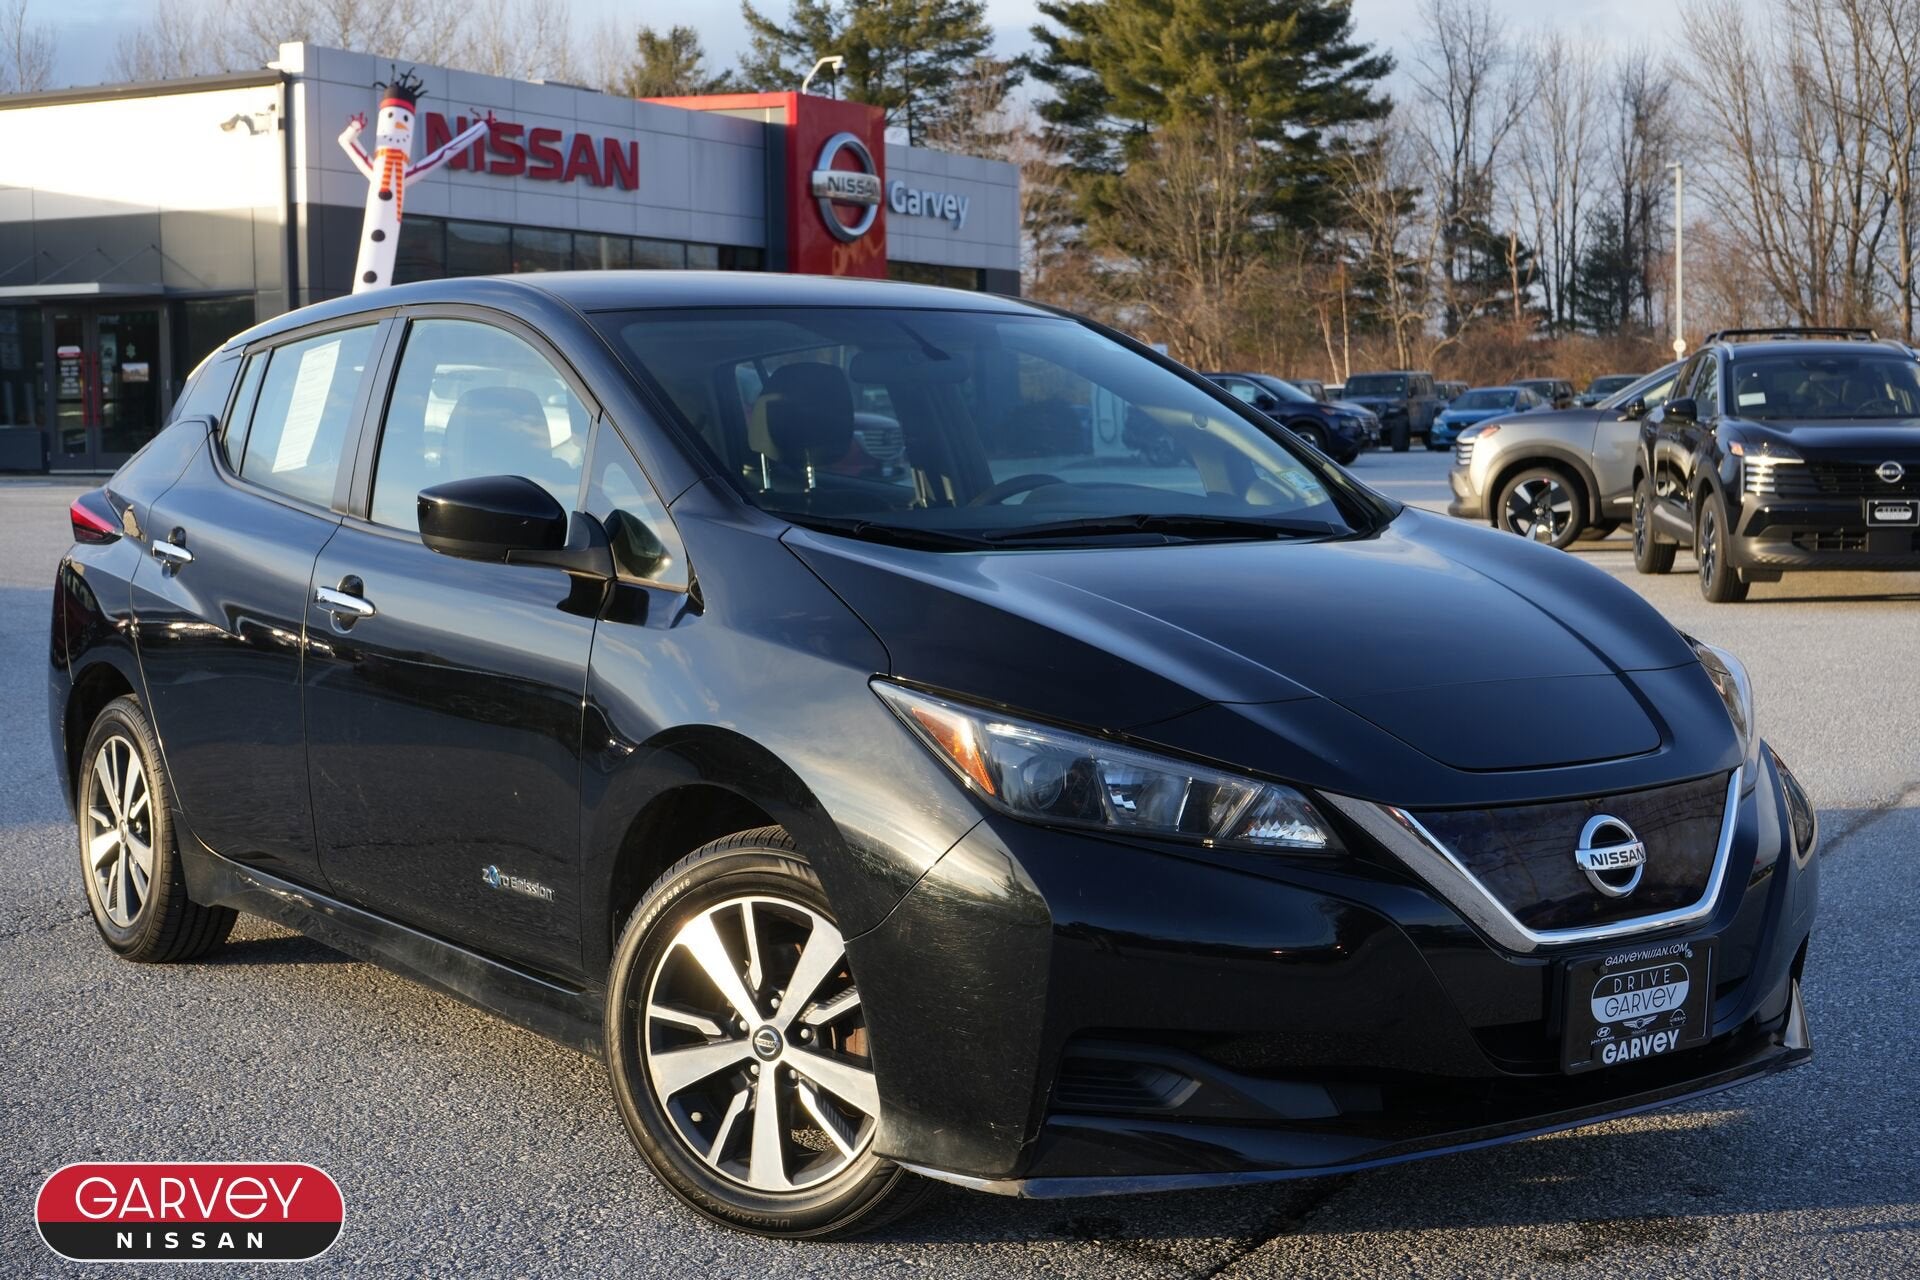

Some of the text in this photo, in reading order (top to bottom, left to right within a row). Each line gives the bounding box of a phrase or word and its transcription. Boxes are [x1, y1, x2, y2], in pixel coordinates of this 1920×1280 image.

[424, 111, 640, 191] NISSAN
[890, 181, 970, 230] Garvey
[1589, 847, 1645, 867] NISSAN
[1613, 968, 1671, 994] DRIVE
